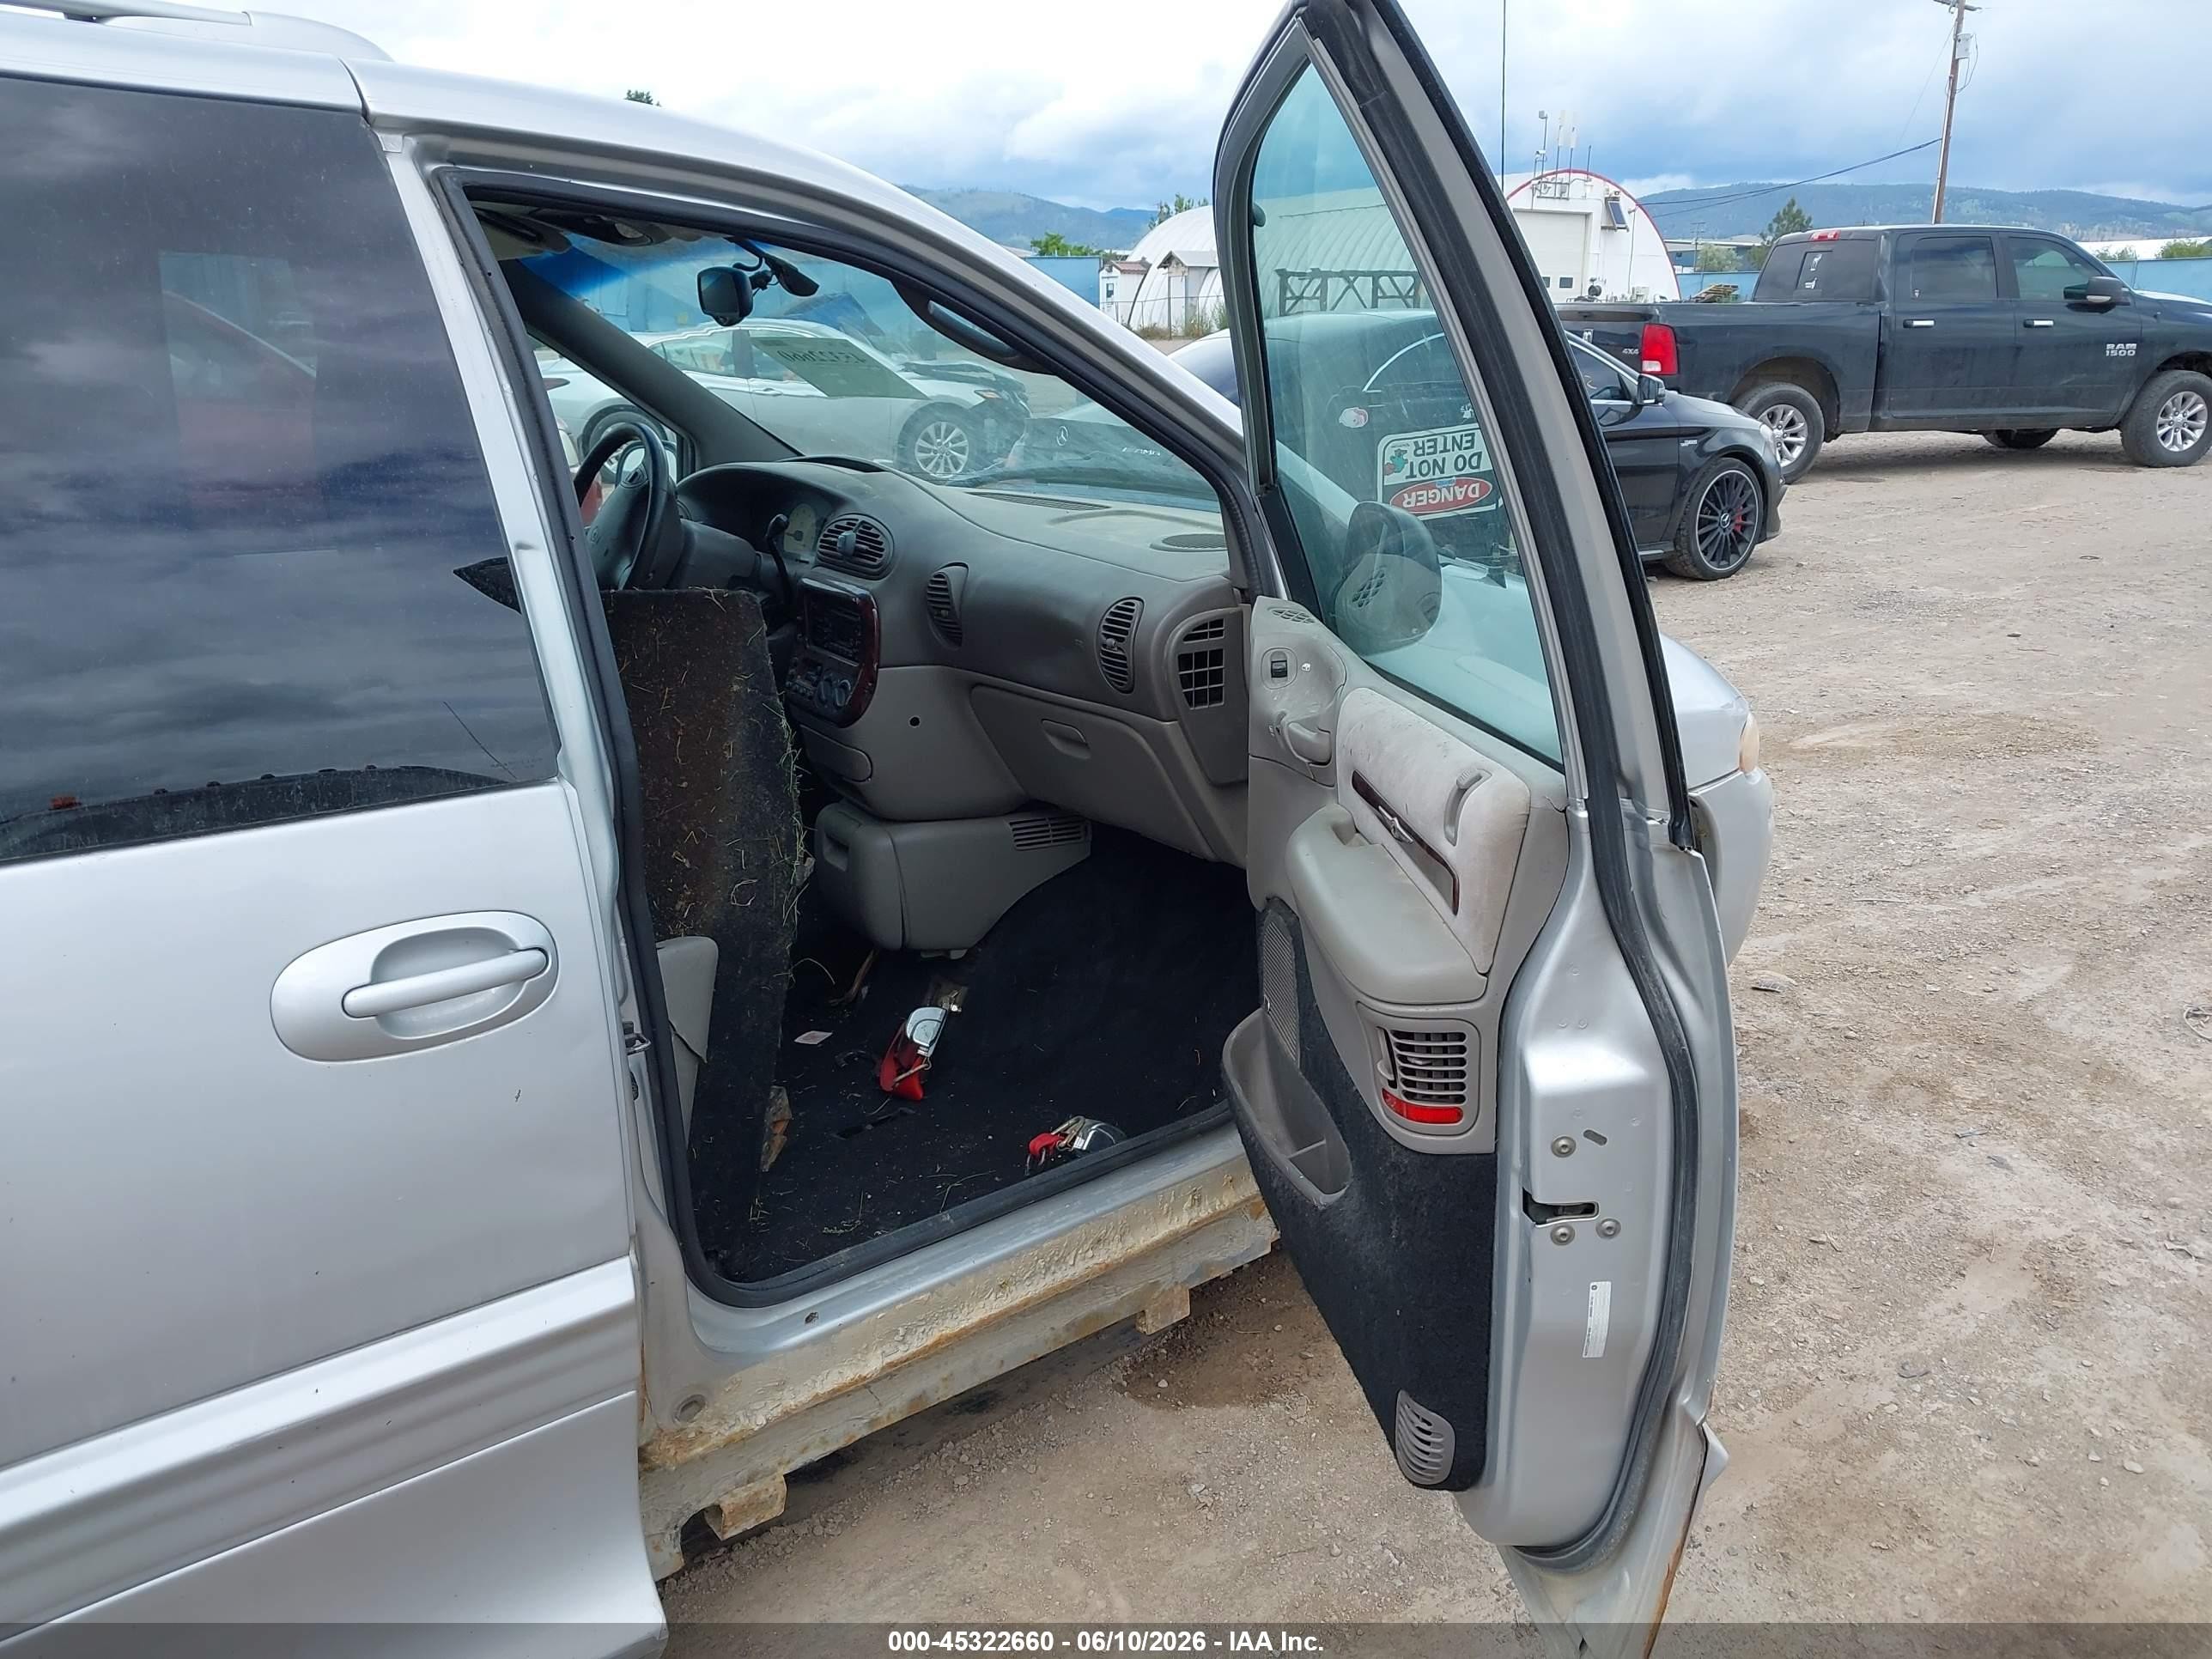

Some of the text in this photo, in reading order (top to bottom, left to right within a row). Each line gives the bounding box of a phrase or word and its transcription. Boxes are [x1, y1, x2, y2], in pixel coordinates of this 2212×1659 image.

[1413, 433, 1475, 456] ENTER
[1406, 452, 1482, 478] DO NOT
[1402, 483, 1480, 507] DANGER
